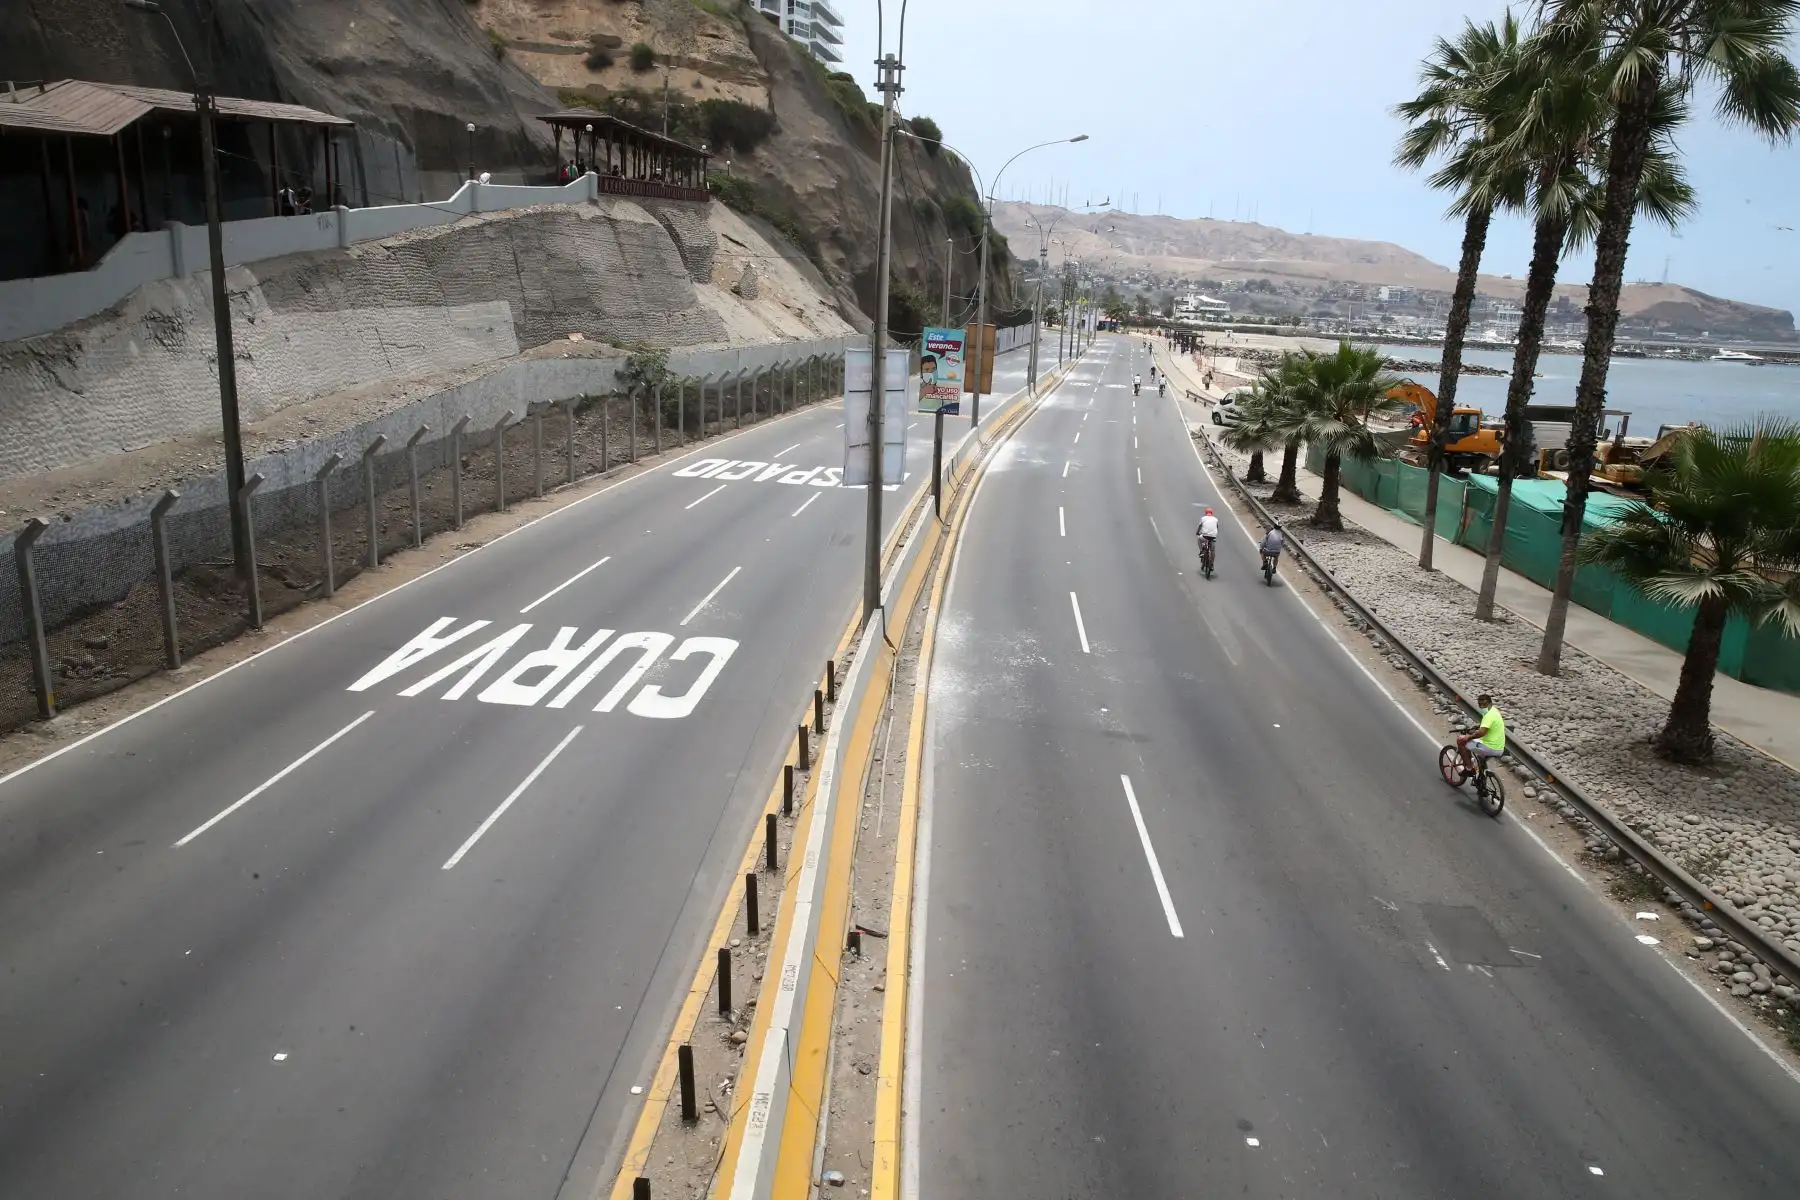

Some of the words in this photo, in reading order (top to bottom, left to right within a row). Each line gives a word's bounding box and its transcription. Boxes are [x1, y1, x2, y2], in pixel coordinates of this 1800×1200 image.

[928, 333, 944, 341] Este
[928, 342, 959, 350] verano...
[672, 458, 911, 492] SPACIO
[347, 616, 740, 719] CURVA
